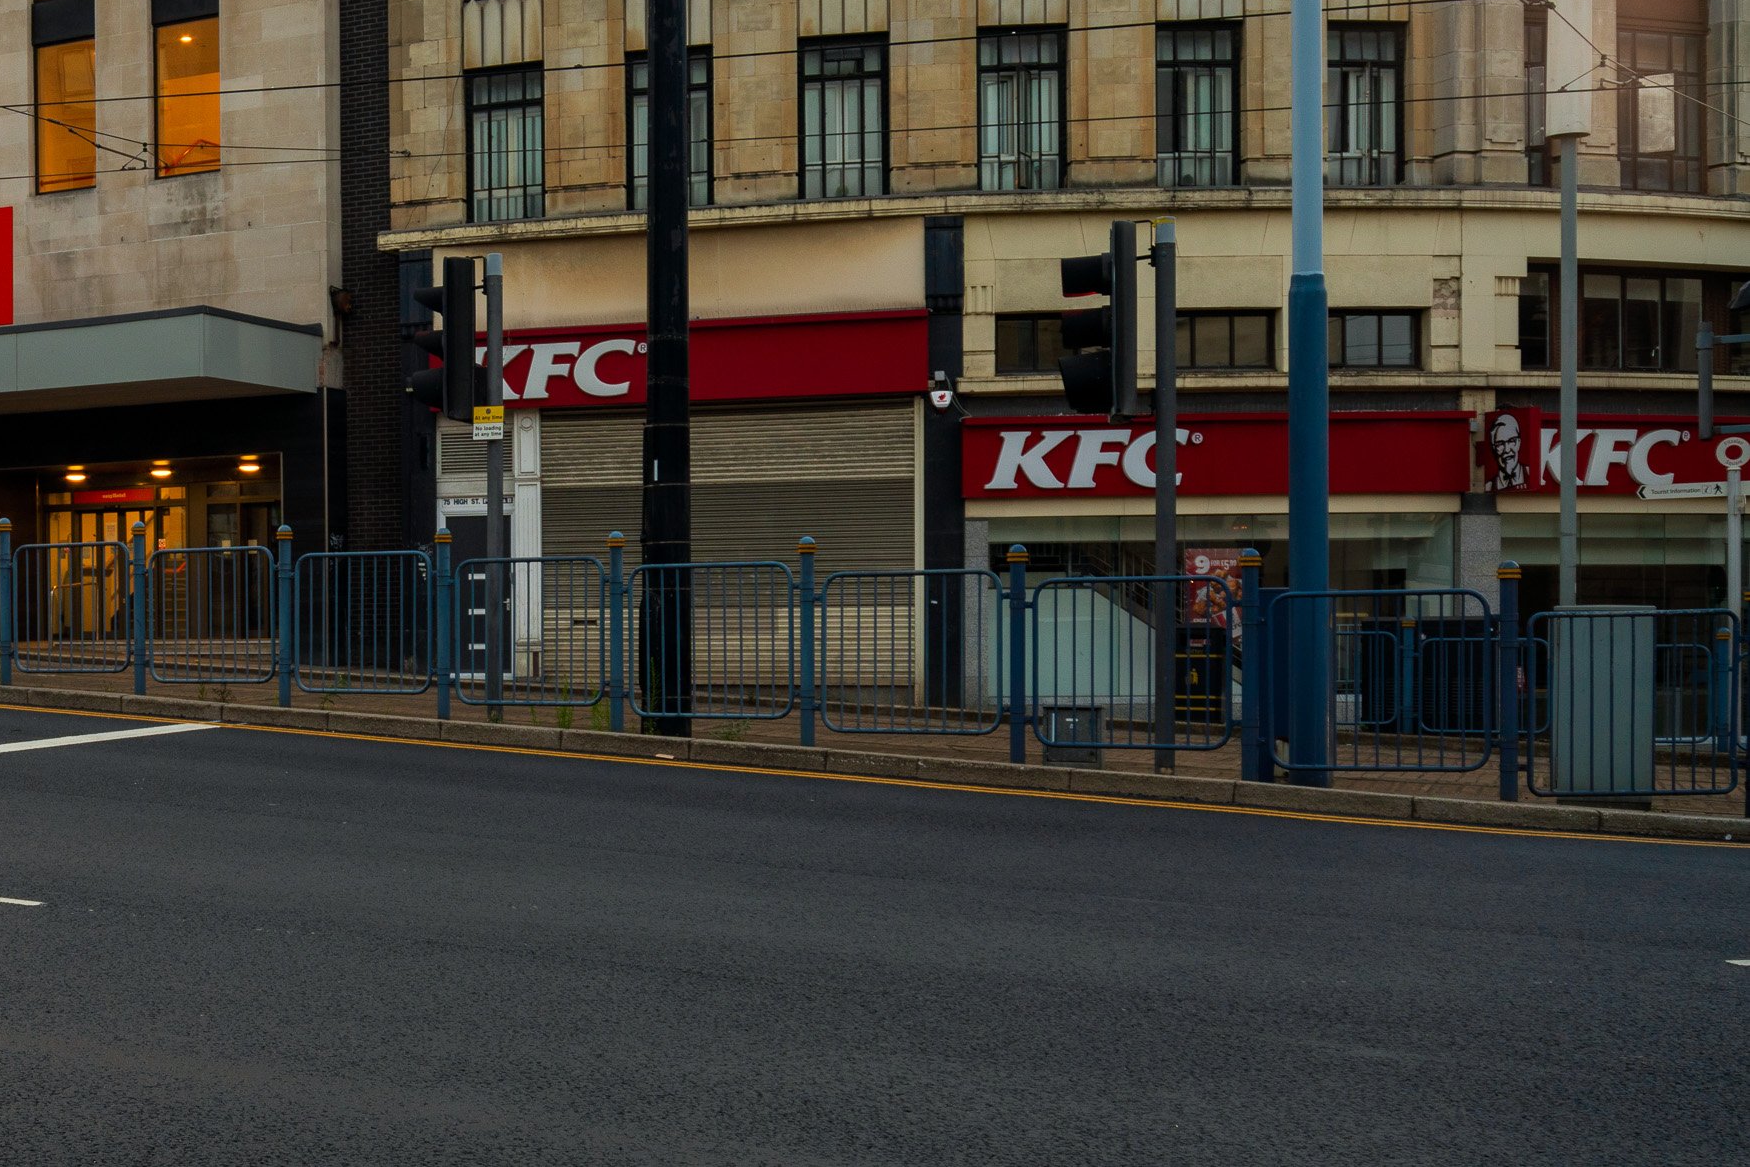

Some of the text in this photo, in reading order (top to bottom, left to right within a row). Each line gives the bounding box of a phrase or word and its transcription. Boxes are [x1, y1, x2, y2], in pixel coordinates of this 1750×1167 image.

[476, 339, 636, 399] FC
[984, 429, 1191, 490] KFC
[1194, 555, 1210, 574] 9
